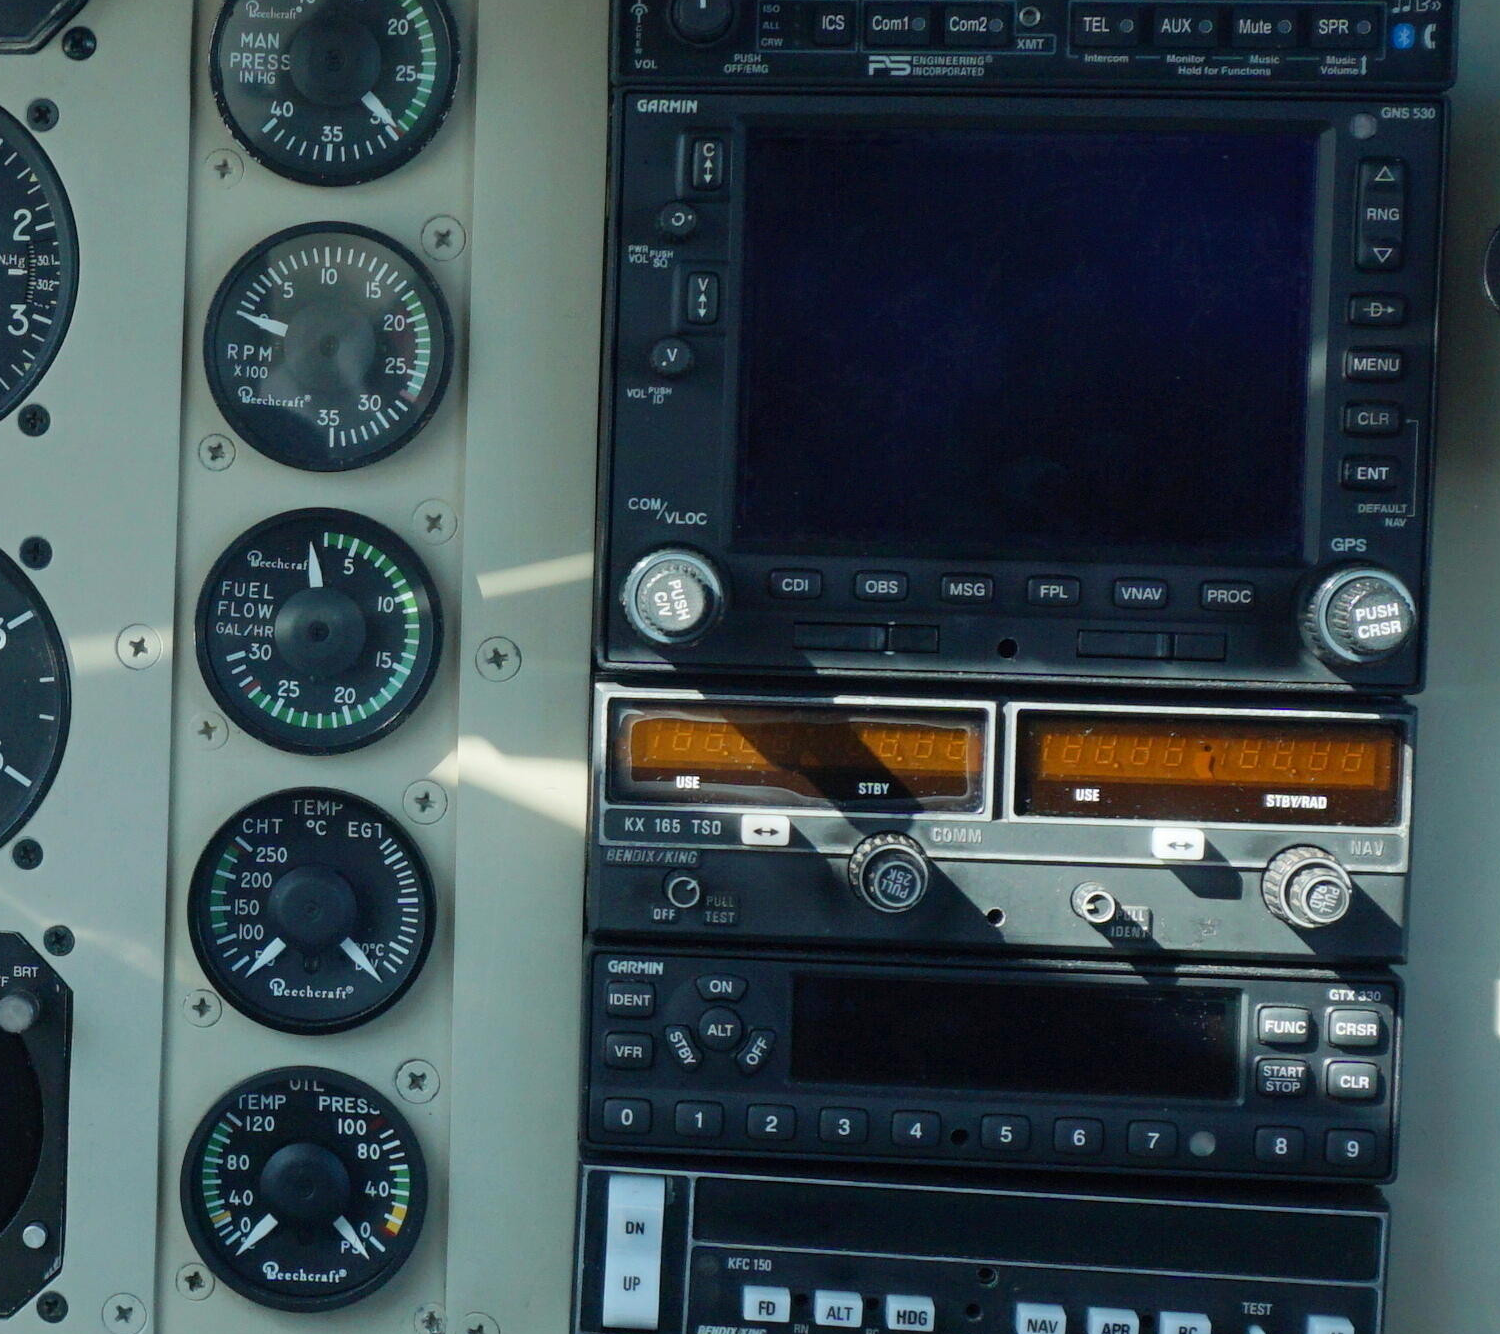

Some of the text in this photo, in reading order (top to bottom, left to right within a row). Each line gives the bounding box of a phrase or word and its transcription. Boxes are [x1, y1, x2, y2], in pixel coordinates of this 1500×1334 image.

[241, 33, 279, 49] MAN
[230, 53, 290, 70] PRESS
[638, 99, 697, 113] GARMIN
[1381, 107, 1436, 119] GNS 530
[1331, 538, 1366, 551] GPS
[222, 581, 274, 599] FUEL
[782, 579, 808, 591] CDI
[866, 581, 898, 593] OBS
[950, 583, 985, 596] MSG
[1040, 585, 1068, 598] FPL
[1122, 587, 1162, 600] VNAV
[1208, 590, 1251, 603] PROC
[218, 601, 273, 619] FLOW
[1356, 603, 1398, 621] PUSH
[216, 622, 273, 637] GAL/HR
[1358, 621, 1402, 639] CRSR
[676, 776, 700, 789] USE
[859, 783, 889, 795] STBY
[1266, 795, 1327, 809] STBY/RAD
[625, 817, 721, 835] KX 165 TSO
[608, 960, 663, 975] GARMIN
[610, 993, 651, 1006] IDENT
[1265, 1020, 1306, 1034] FUNC
[1336, 1023, 1377, 1036] CRSR
[626, 1221, 644, 1235] DN
[624, 1276, 640, 1291] UP
[826, 1306, 853, 1321] ALT
[1242, 1302, 1272, 1315] TEST
[897, 1310, 927, 1325] HDG
[1027, 1319, 1058, 1333] NAV
